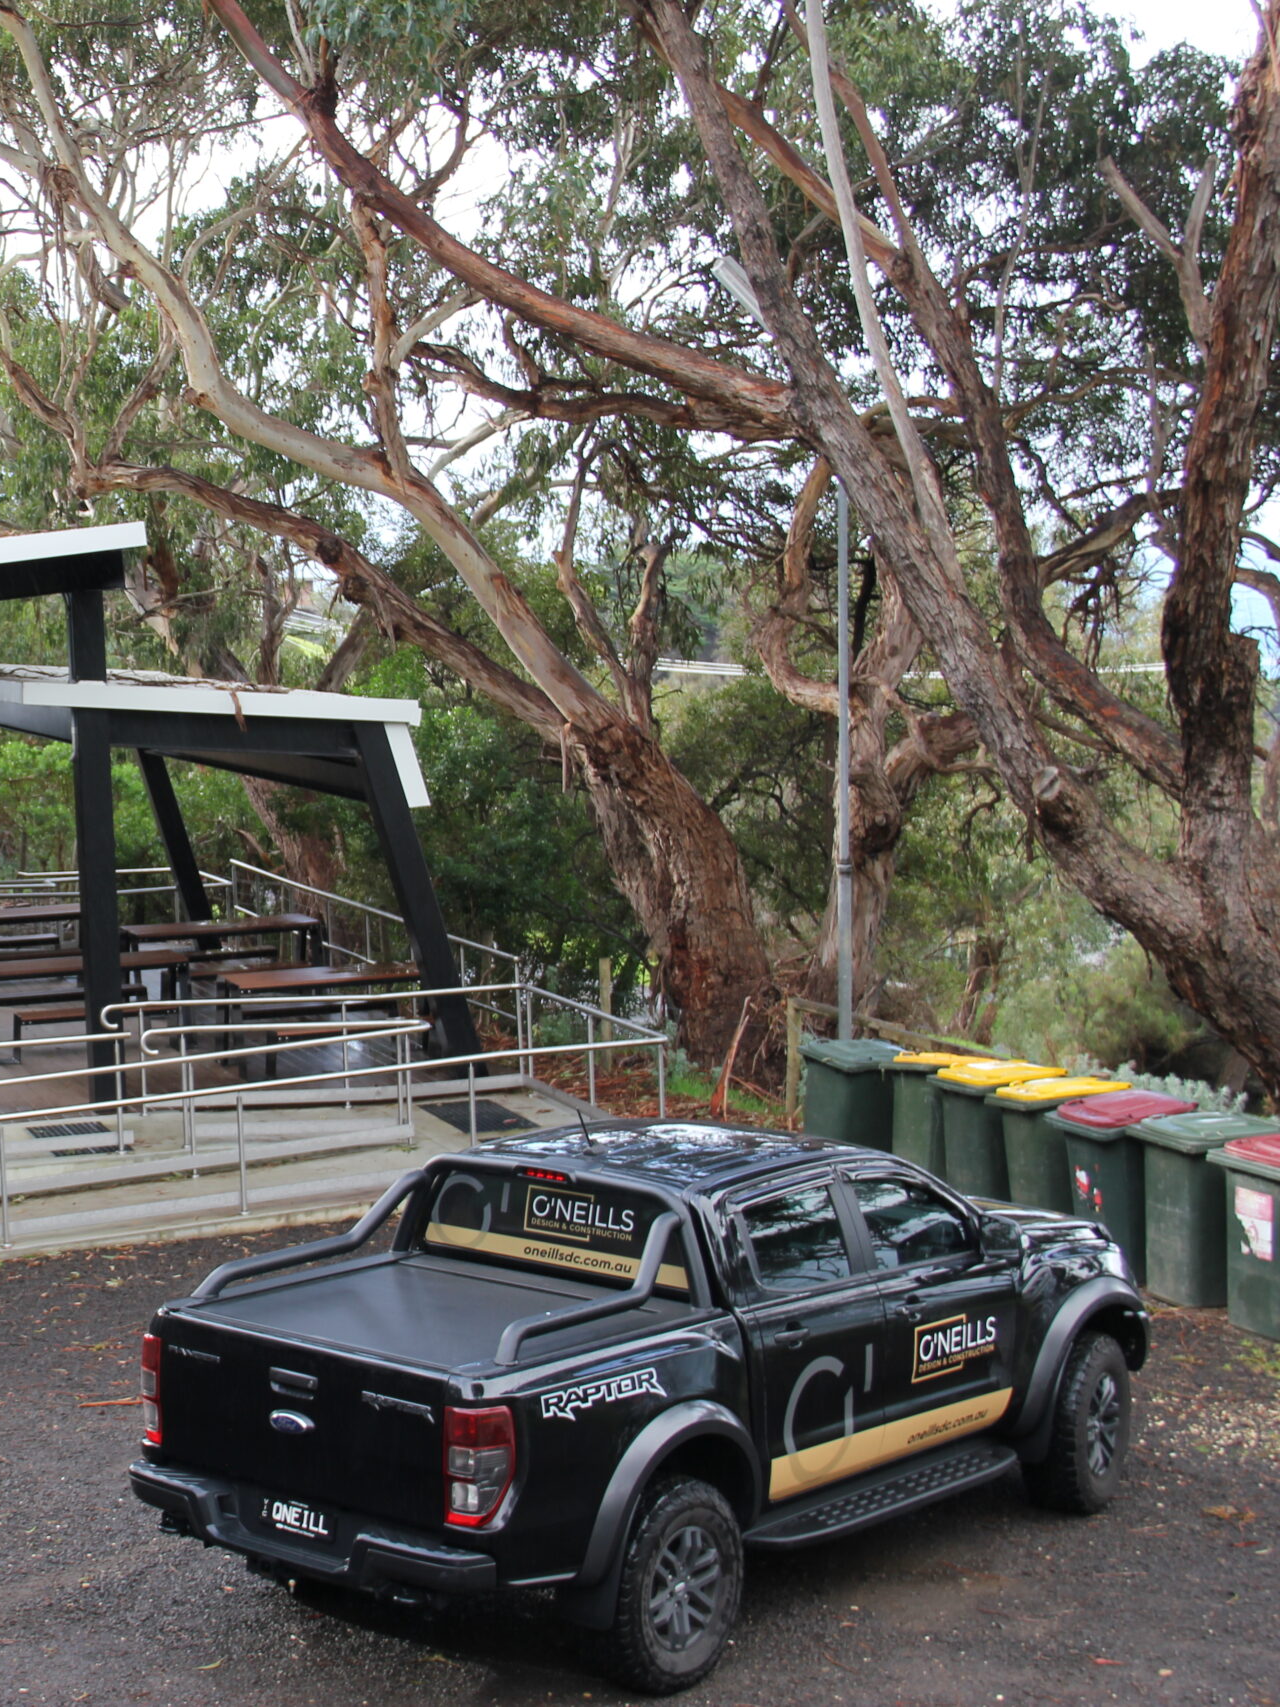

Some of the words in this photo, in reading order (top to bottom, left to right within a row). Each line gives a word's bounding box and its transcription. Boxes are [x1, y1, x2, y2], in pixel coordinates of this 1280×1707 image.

[531, 1217, 560, 1229] DESIGN
[561, 1222, 568, 1231] &
[569, 1223, 632, 1241] CONSTRUCTION
[532, 1195, 635, 1232] O'NEILLS
[523, 1246, 633, 1274] oneillsdc.com.au
[919, 1315, 996, 1361] O'NEILLS
[919, 1359, 942, 1373] DESIGN
[948, 1344, 995, 1364] CONSTRUCTION
[541, 1367, 667, 1421] RAPTOR
[907, 1408, 989, 1445] oneillsdc.com.au
